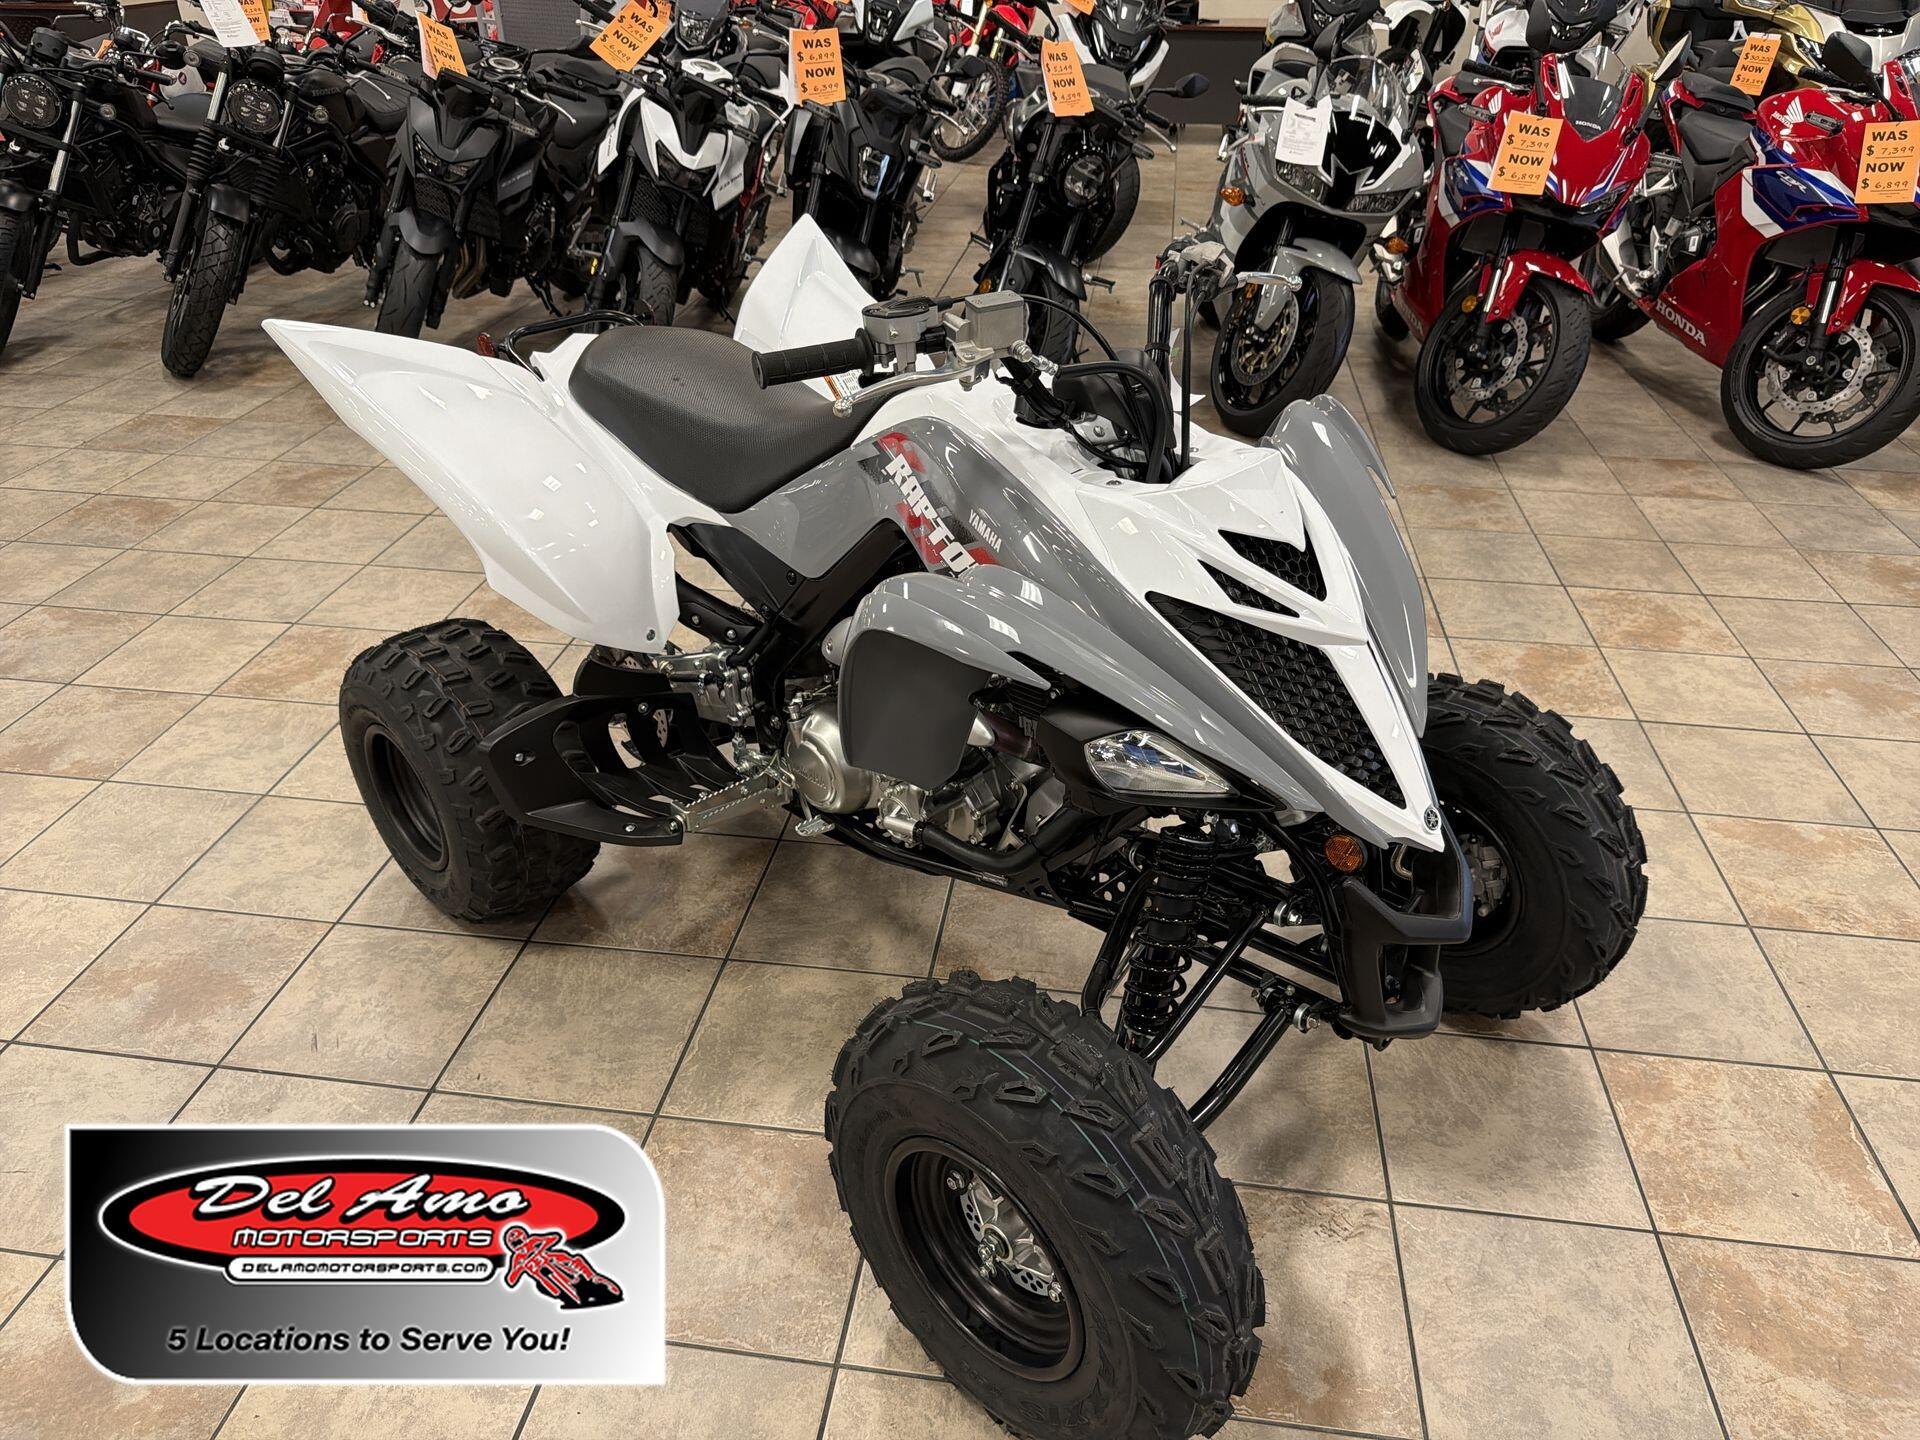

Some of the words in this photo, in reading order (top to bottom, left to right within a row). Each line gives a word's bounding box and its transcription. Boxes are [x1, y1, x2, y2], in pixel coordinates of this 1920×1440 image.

[617, 14, 627, 24] $
[629, 12, 655, 33] WAS
[427, 23, 449, 40] WAS
[600, 33, 610, 43] $
[612, 29, 640, 52] NOW
[802, 37, 832, 49] WAS
[433, 46, 457, 62] NOW
[1750, 43, 1771, 53] WAS
[797, 51, 805, 63] $
[809, 51, 835, 61] 6,899
[1047, 52, 1069, 62] WAS
[1744, 52, 1750, 61] $
[805, 66, 836, 78] NOW
[1045, 62, 1051, 73] $
[1740, 64, 1764, 74] NOW
[1052, 77, 1076, 88] NOW
[1735, 73, 1741, 82] $
[801, 82, 809, 93] $
[1052, 91, 1058, 101] $
[1518, 122, 1551, 138] WAS
[1575, 119, 1602, 131] HONDA
[1506, 133, 1516, 146] $
[1519, 139, 1550, 149] 7,399
[1871, 129, 1908, 142] WAS
[1866, 144, 1875, 157] $
[1881, 146, 1915, 156] 7,399
[1508, 153, 1545, 167] NOW
[1497, 165, 1507, 177] $
[1510, 171, 1541, 181] 6,899
[1865, 161, 1905, 173] NOW
[1861, 178, 1870, 190] $
[1874, 180, 1909, 190] 6,899
[1655, 298, 1707, 347] HONDA
[884, 453, 979, 577] RAPTO
[968, 508, 1003, 553] YAMAHA
